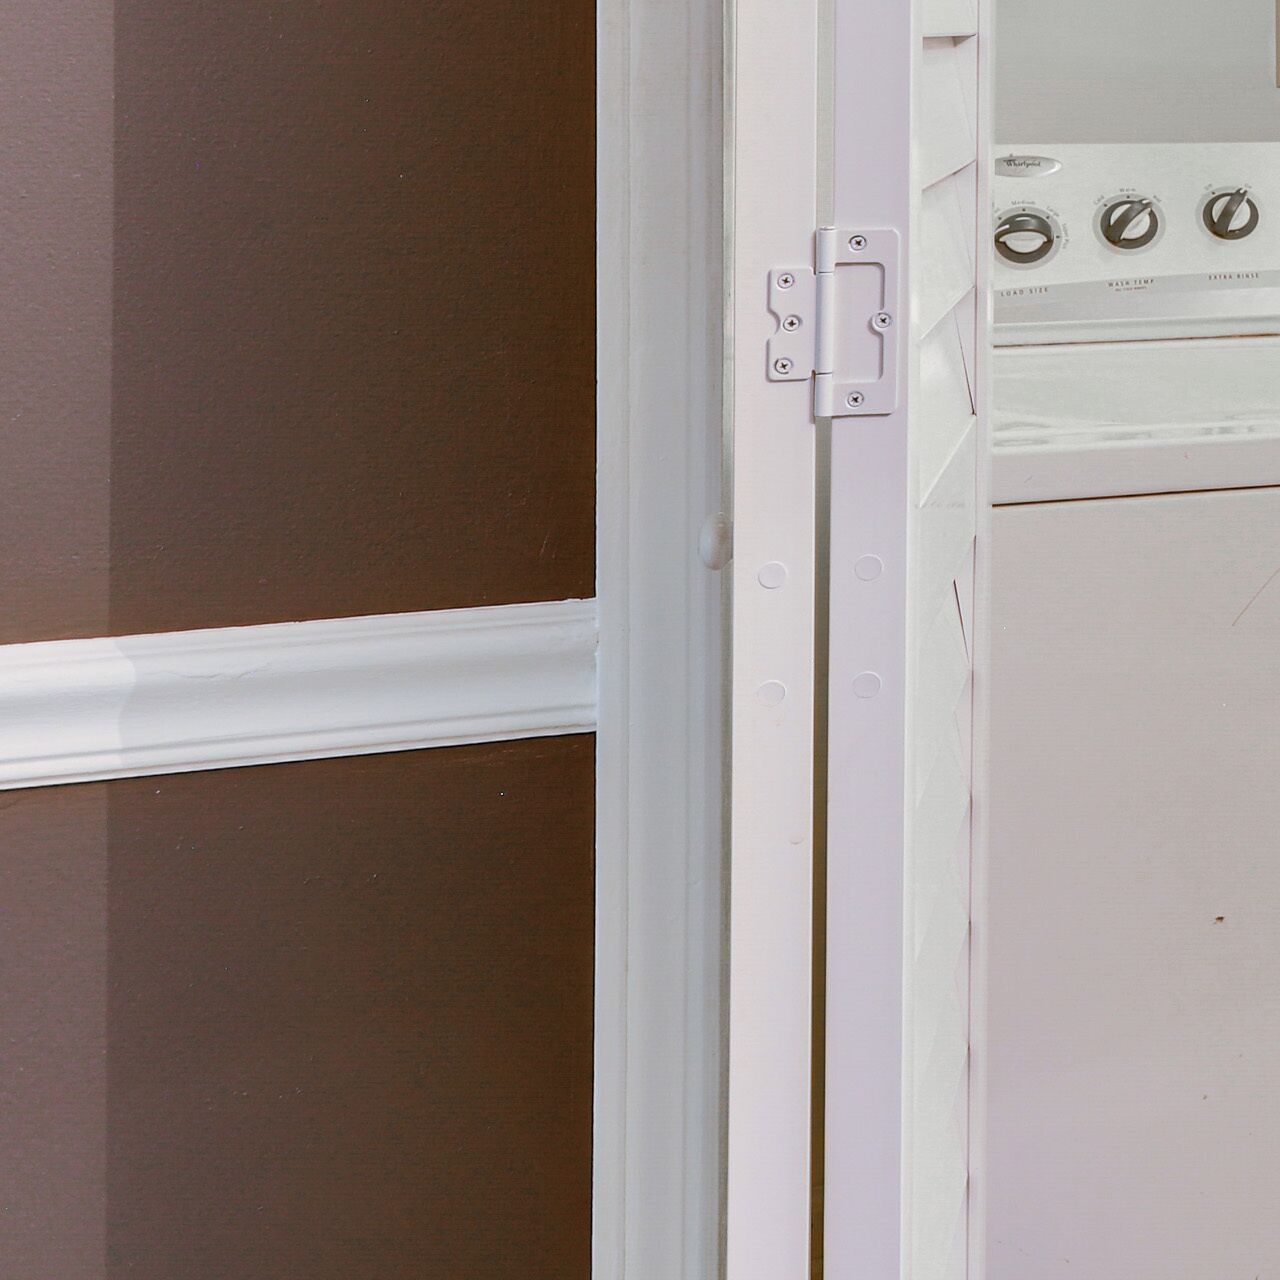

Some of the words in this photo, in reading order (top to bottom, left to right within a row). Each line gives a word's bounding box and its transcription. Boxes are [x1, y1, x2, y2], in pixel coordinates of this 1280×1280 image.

[1003, 159, 1041, 169] Whirlpool
[1000, 289, 1025, 297] LOAD
[1029, 287, 1048, 295] SIZE
